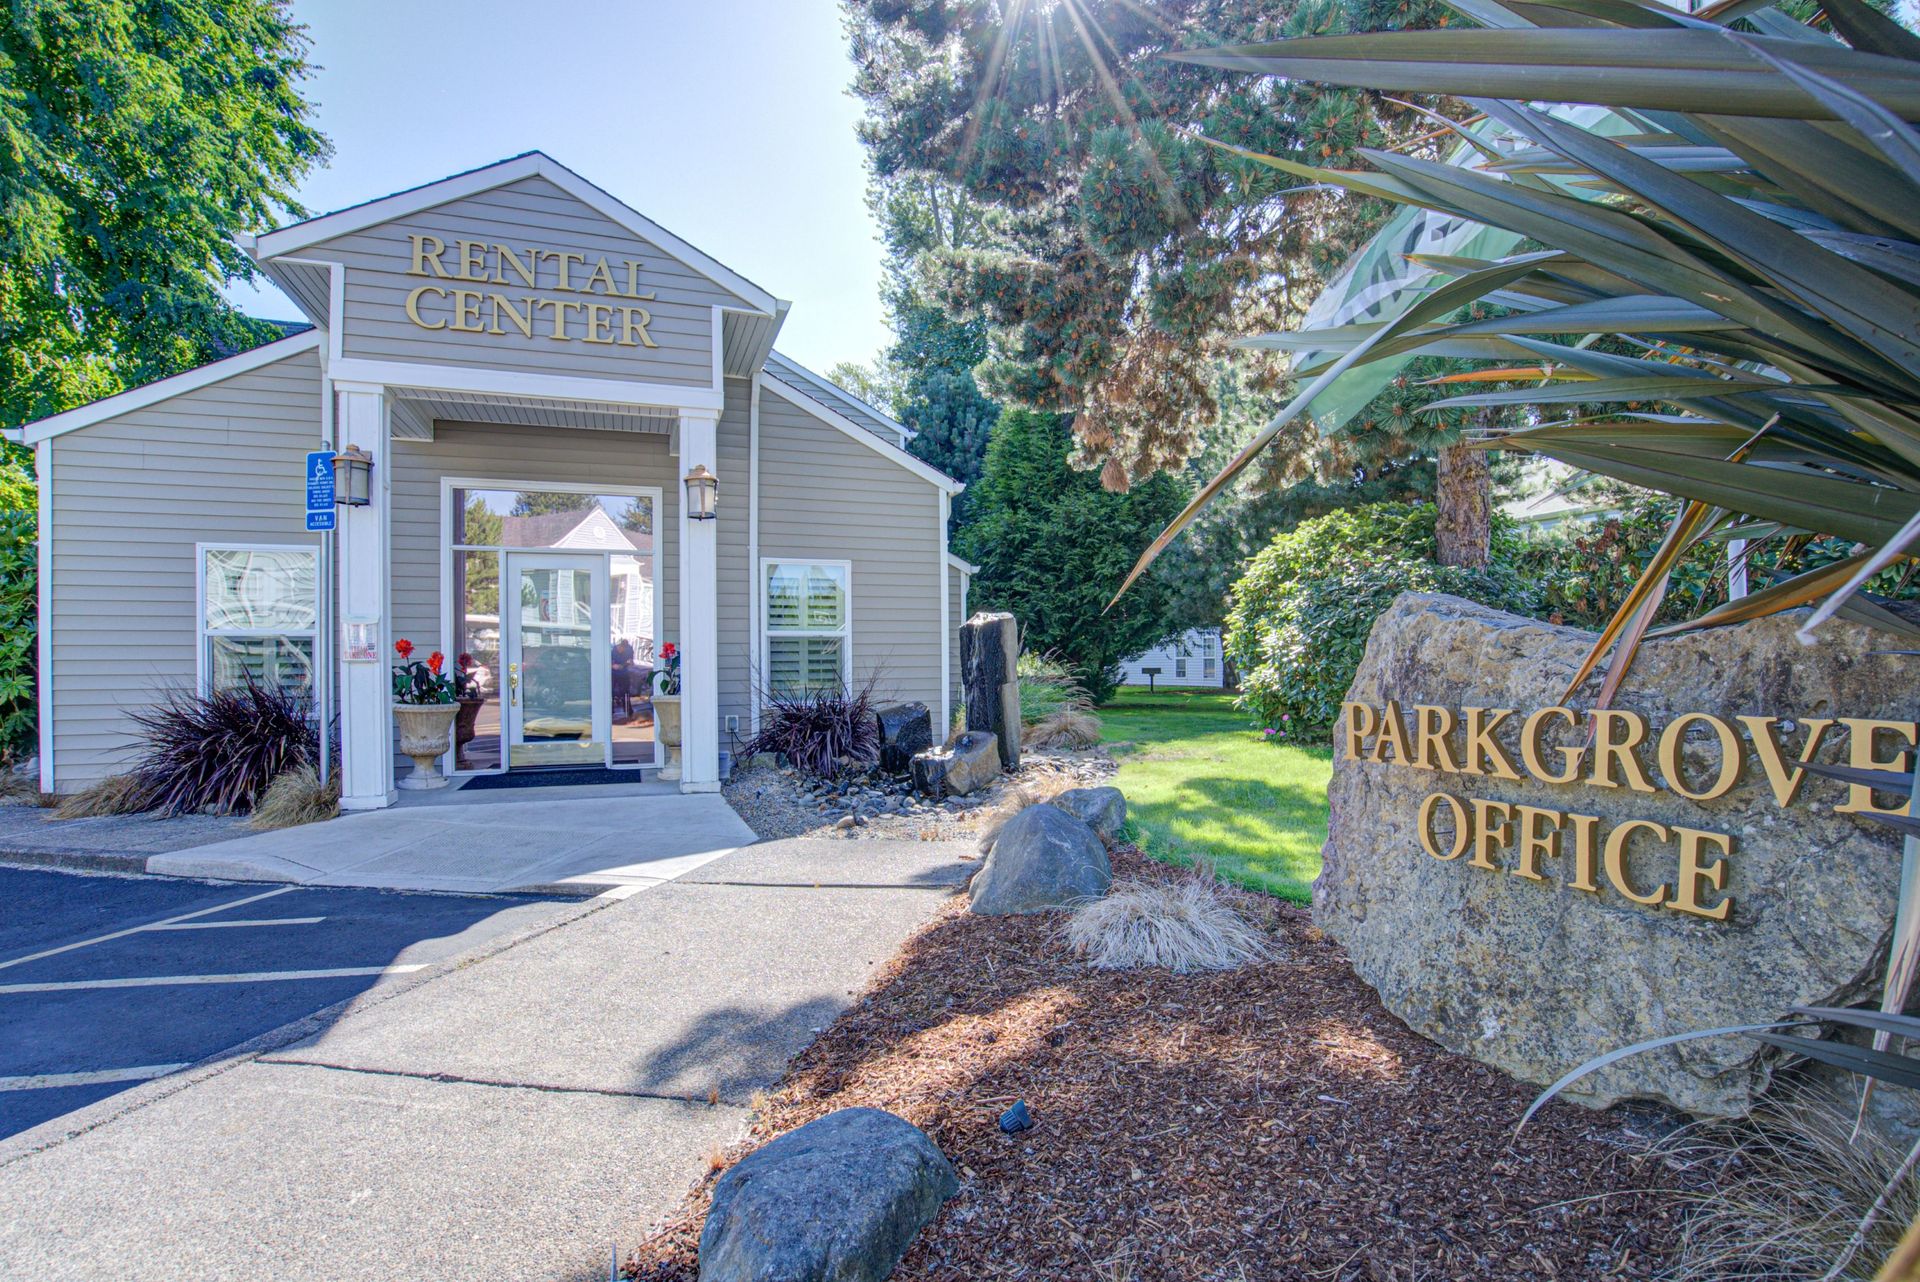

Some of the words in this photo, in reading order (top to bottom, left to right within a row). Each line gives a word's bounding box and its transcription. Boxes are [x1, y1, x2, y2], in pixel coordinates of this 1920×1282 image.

[406, 235, 655, 299] RENTAL
[405, 287, 658, 347] CENTER
[314, 514, 328, 522] VAN
[1341, 701, 1916, 816] PARKGROVE
[1417, 792, 1734, 919] OFFICE
